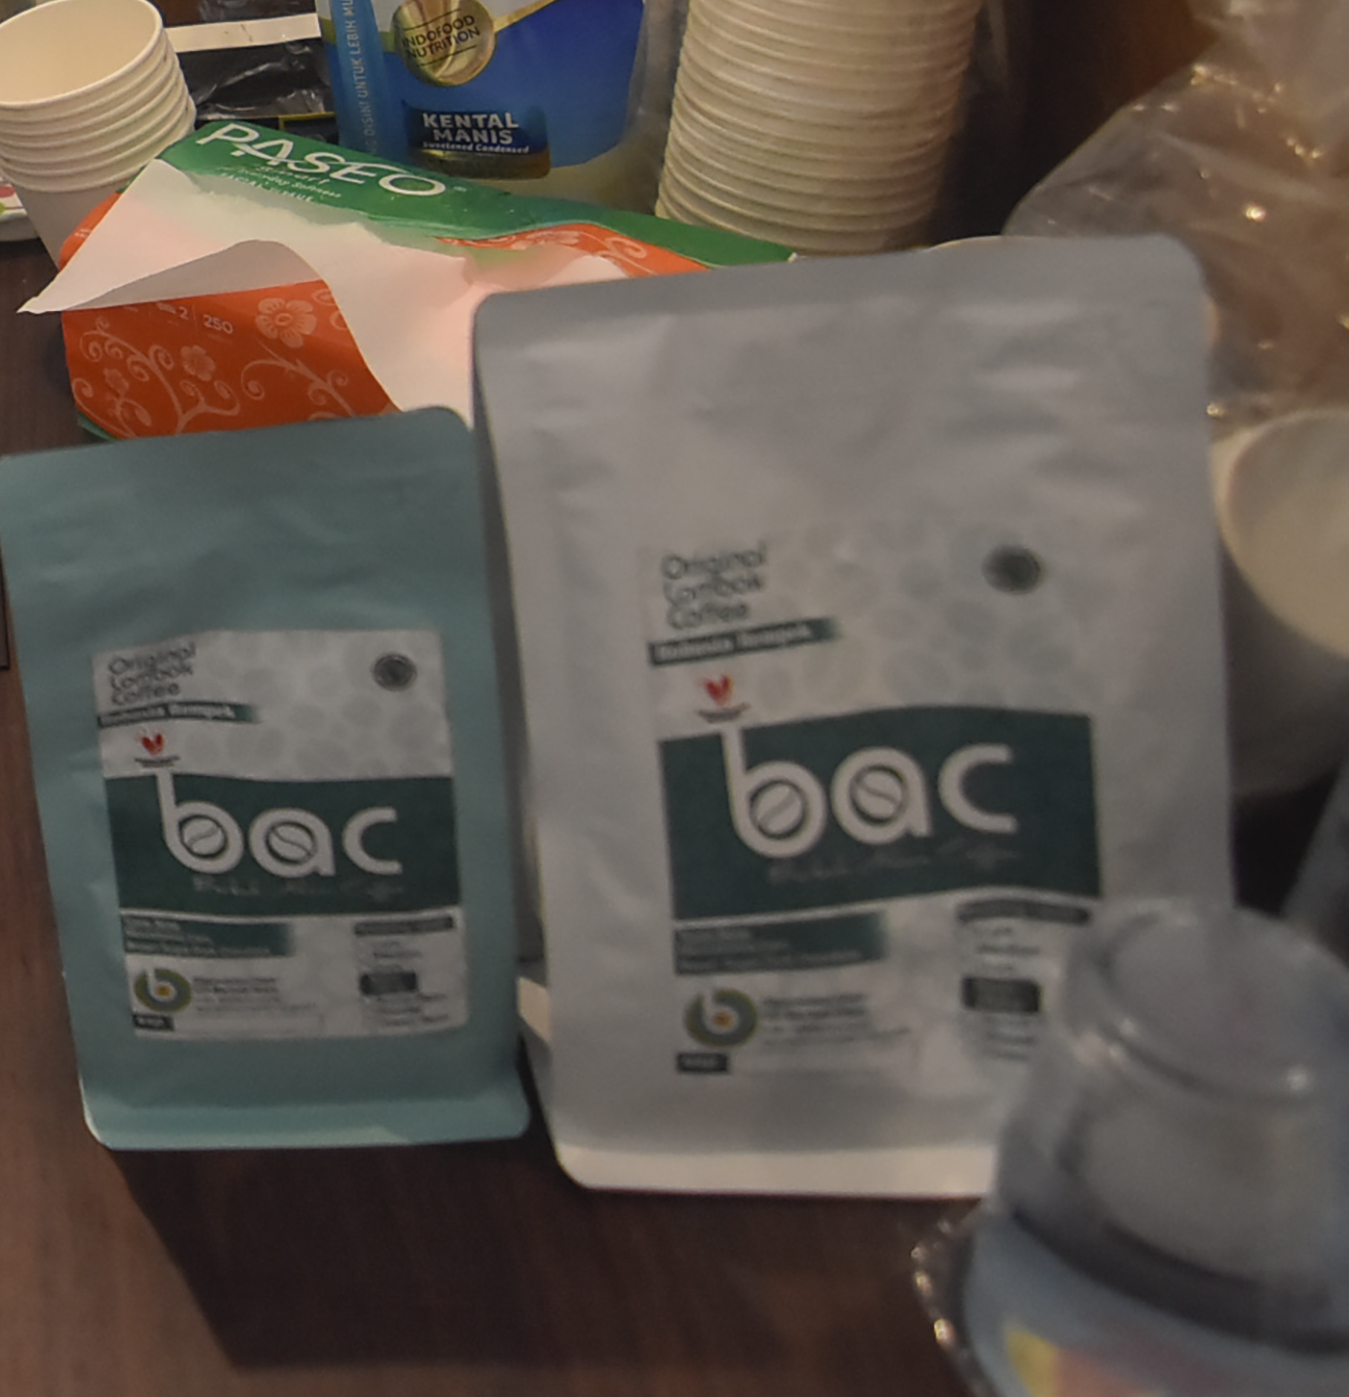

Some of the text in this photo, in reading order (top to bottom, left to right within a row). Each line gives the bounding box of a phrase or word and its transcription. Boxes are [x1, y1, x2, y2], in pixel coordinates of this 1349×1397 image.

[344, 19, 361, 54] LEBIH
[402, 14, 476, 48] INDOFOOD
[406, 26, 481, 60] NUTRITION
[351, 55, 369, 98] UNTUK
[422, 112, 519, 129] KENTAL
[433, 127, 513, 144] MANIS
[195, 123, 446, 196] PASEO
[721, 727, 1018, 859] bac
[156, 770, 402, 878] bac
